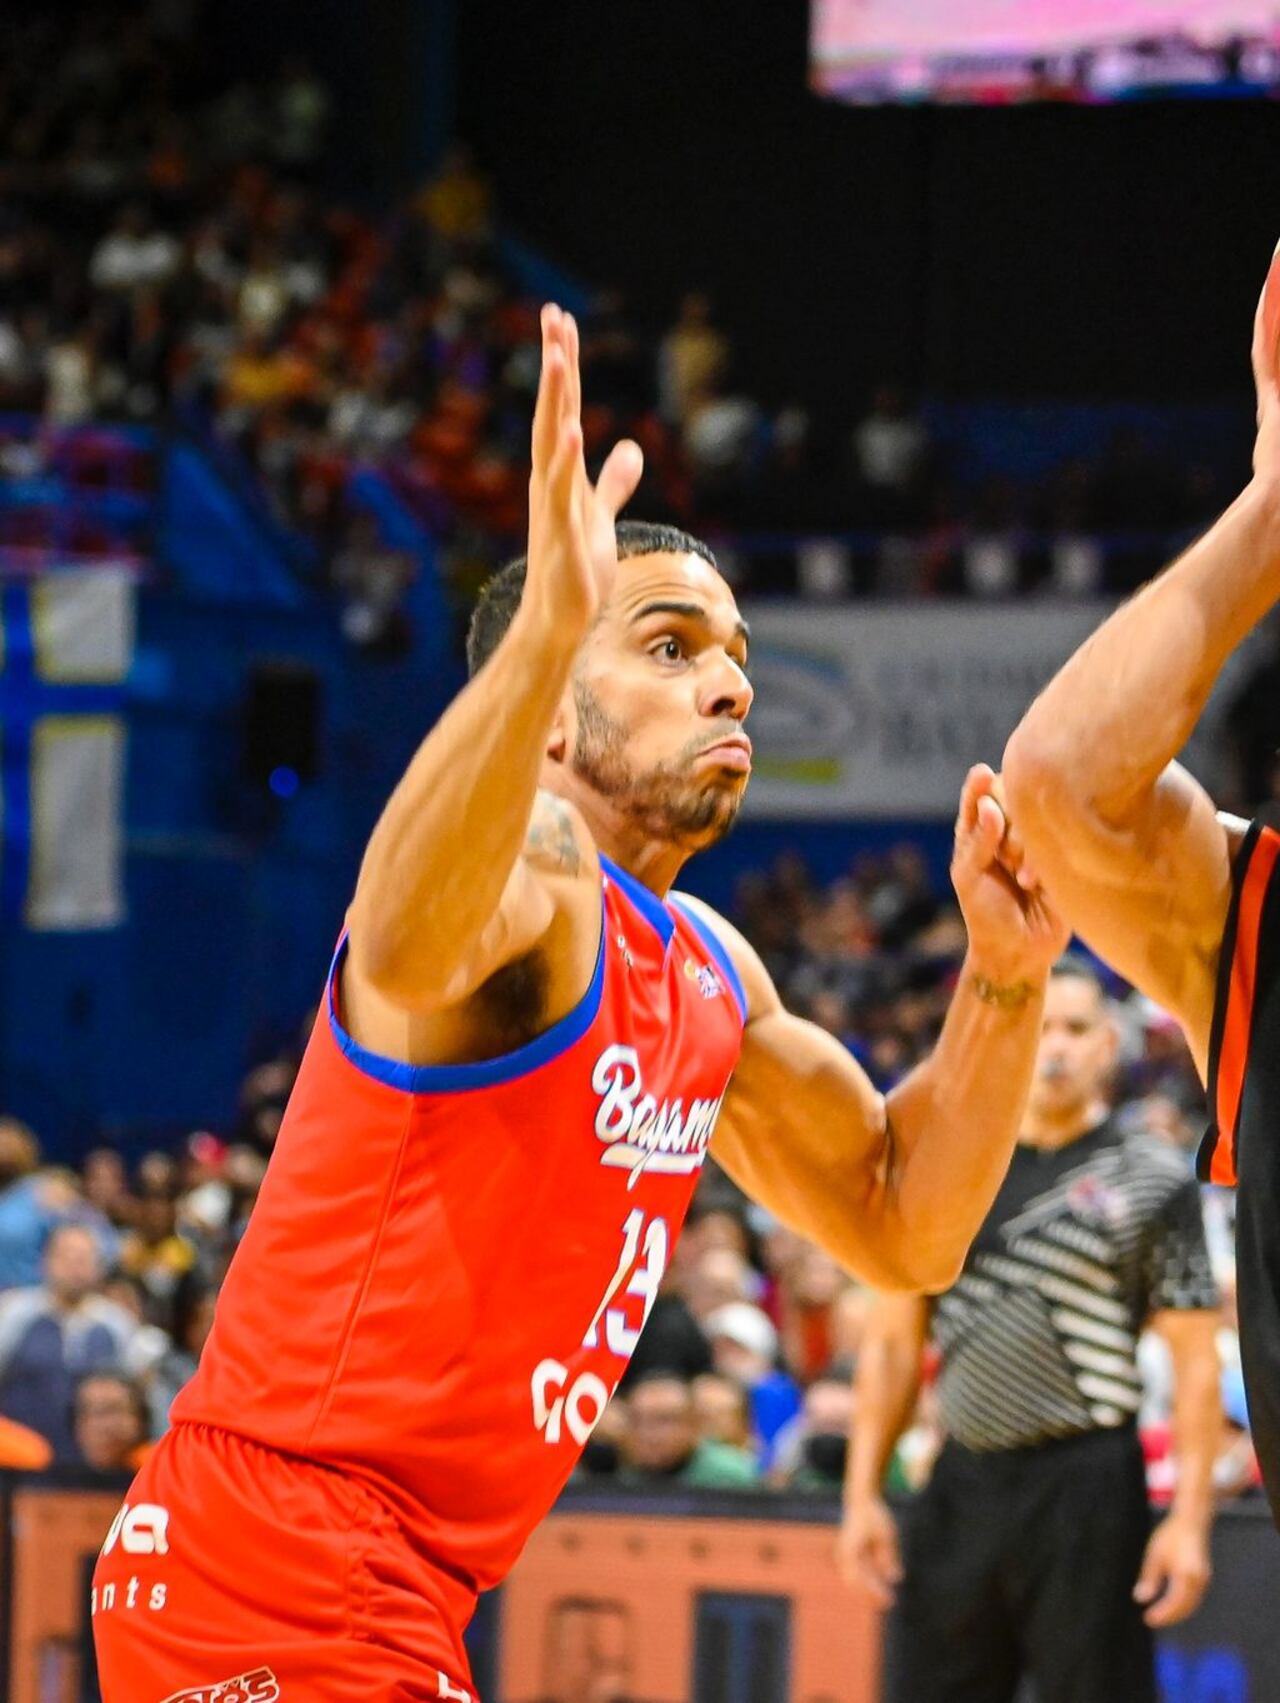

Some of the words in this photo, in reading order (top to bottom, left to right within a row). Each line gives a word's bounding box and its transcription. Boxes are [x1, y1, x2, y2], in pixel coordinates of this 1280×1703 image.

[592, 1043, 732, 1191] Bayam
[581, 1208, 669, 1359] 13
[531, 1358, 620, 1446] GO
